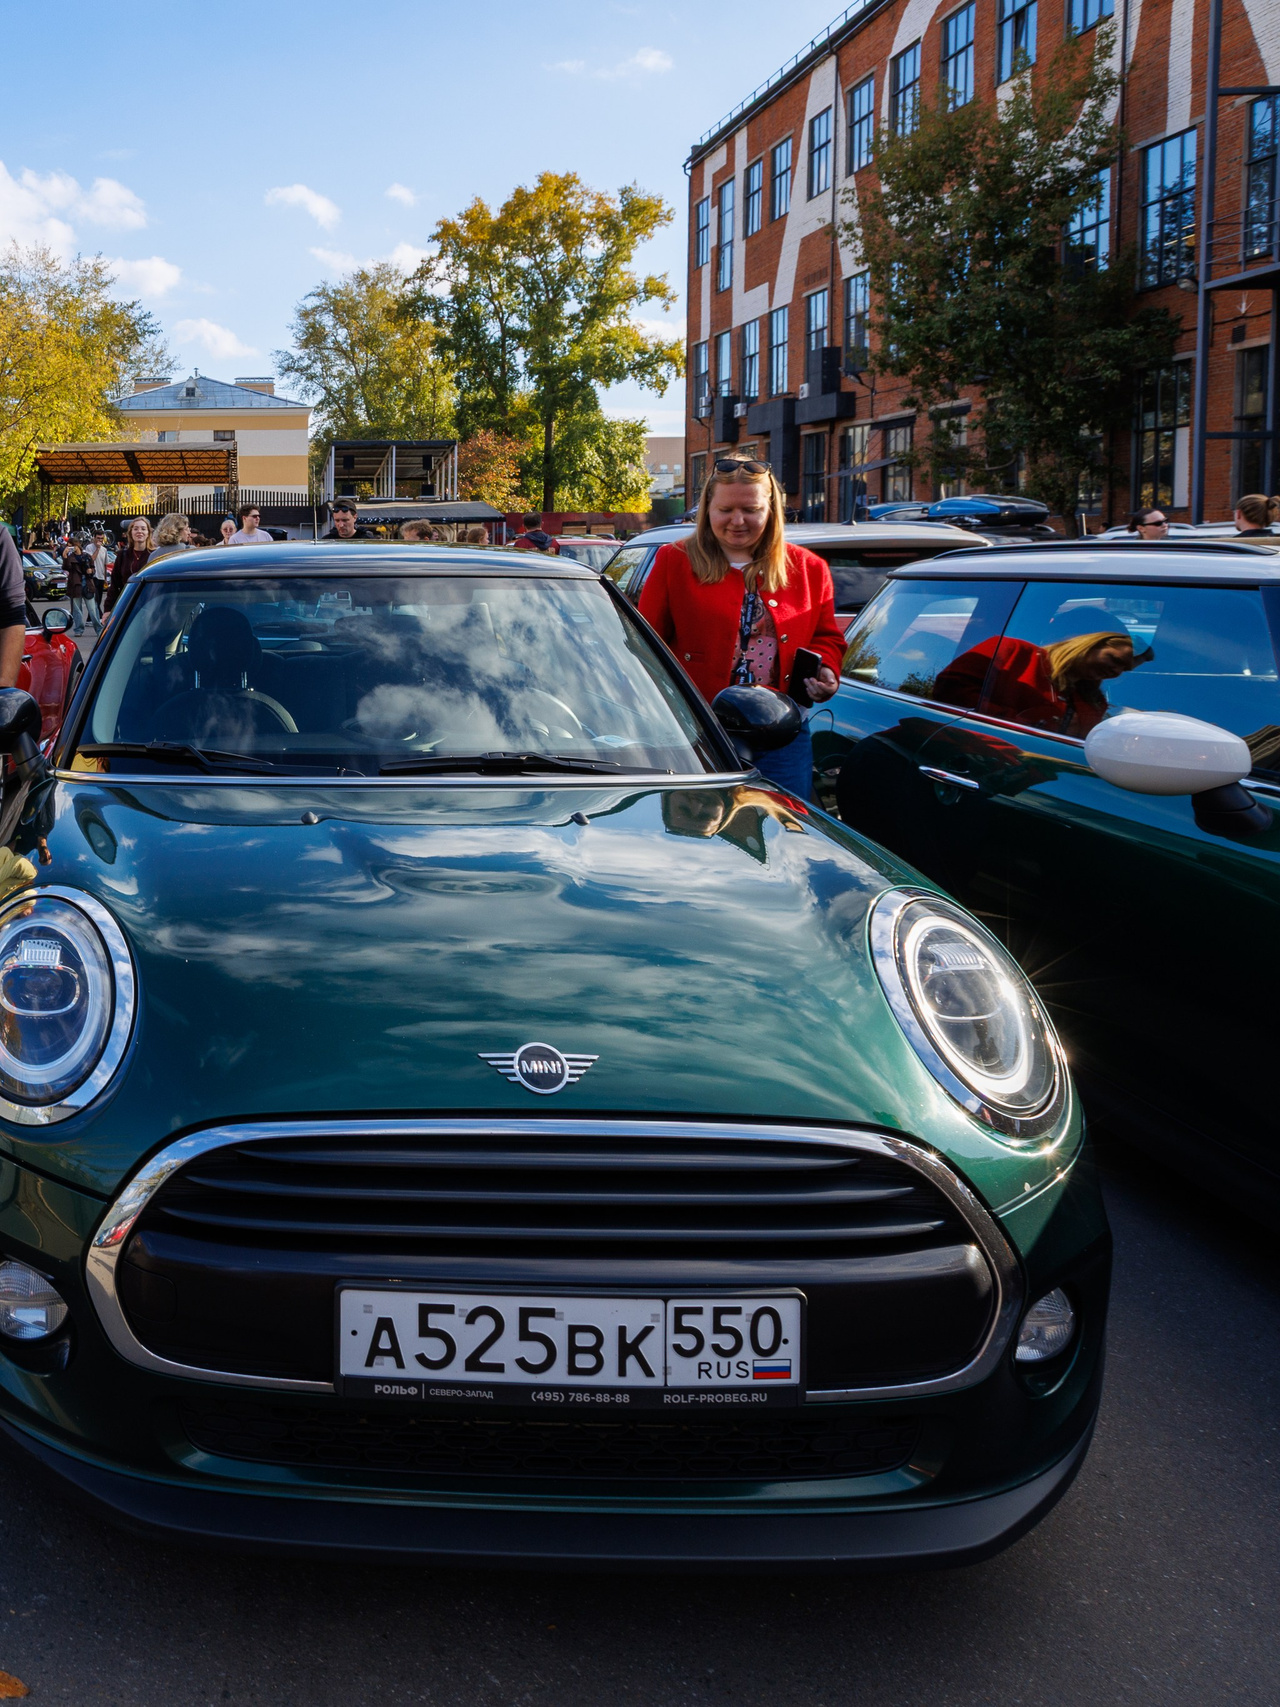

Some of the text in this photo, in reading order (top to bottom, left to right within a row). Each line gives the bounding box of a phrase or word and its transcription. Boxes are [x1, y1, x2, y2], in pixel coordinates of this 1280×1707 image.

[520, 1060, 562, 1074] MINI
[672, 1306, 782, 1358] 550
[698, 1361, 750, 1379] RUS
[374, 1384, 494, 1399] РОЛЬФ СЕВЕРО-ЗАПАД
[531, 1391, 630, 1403] (495) 786-88-88
[663, 1393, 768, 1404] ROLF-PROBEG.RU
